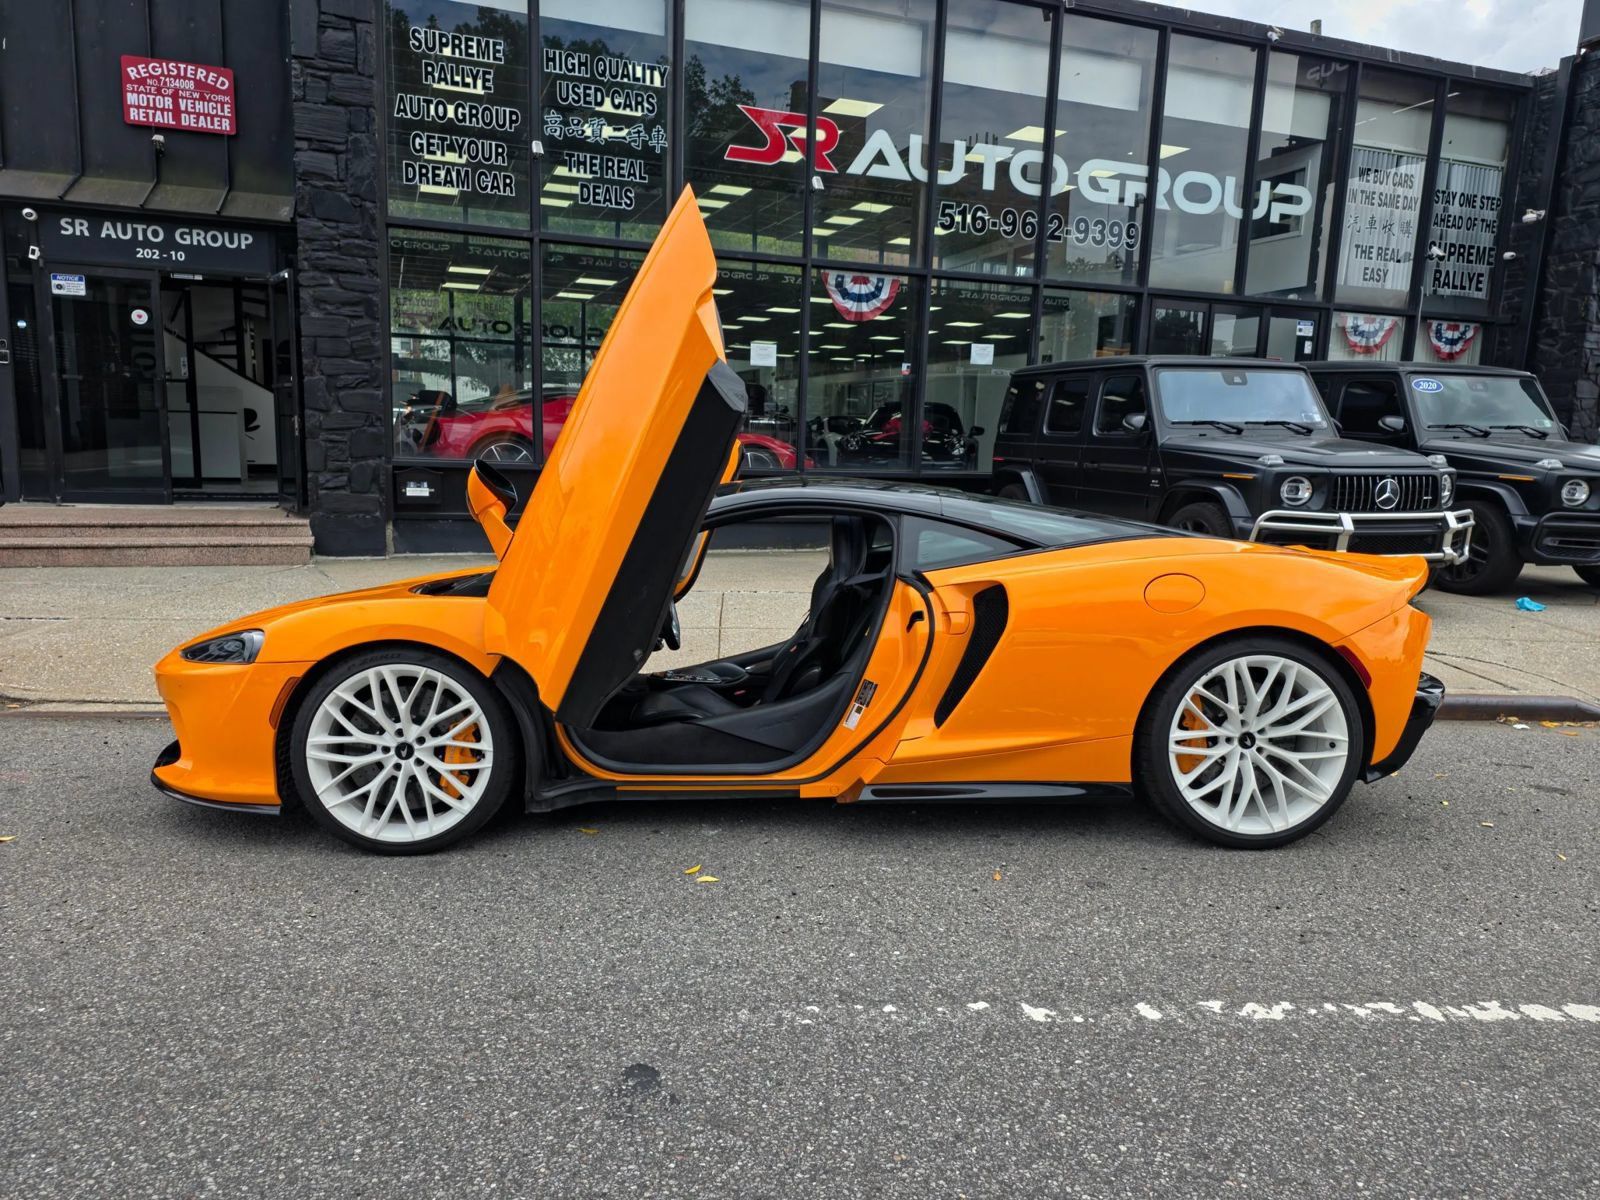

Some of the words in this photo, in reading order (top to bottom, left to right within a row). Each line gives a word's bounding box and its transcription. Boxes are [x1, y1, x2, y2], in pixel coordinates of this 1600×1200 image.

[410, 27, 504, 64] SUPREME
[127, 62, 229, 90] REGISTERED
[422, 60, 493, 93] RALLYE
[544, 49, 590, 77] HIGH
[595, 56, 669, 88] QUALITY
[126, 84, 157, 94] STATE
[179, 90, 200, 99] NEW
[204, 93, 231, 103] YORK
[127, 92, 173, 109] MOTOR
[179, 98, 232, 117] VEHICLE
[557, 82, 606, 108] USED
[609, 88, 657, 116] CARS
[129, 107, 176, 125] RETAIL
[181, 113, 230, 131] DEALER
[394, 94, 449, 123] AUTO
[453, 101, 521, 131] GROUP
[544, 109, 668, 154] 高品質二手車
[410, 131, 449, 157] GET
[451, 136, 508, 166] YOUR
[564, 151, 600, 177] THE
[603, 157, 648, 183] REAL
[724, 104, 839, 174] SR
[846, 128, 1069, 197] AUTO
[1077, 158, 1313, 223] GROUP
[403, 161, 471, 192] DREAM
[476, 169, 516, 197] CAR
[1358, 167, 1373, 184] WE
[1373, 169, 1391, 187] BUY
[1392, 172, 1415, 190] CARS
[578, 182, 635, 210] DEALS
[1348, 188, 1358, 204] IN
[1359, 189, 1377, 206] THE
[1377, 191, 1401, 210] SAME
[1401, 195, 1420, 213] DAY
[1434, 189, 1456, 207] STAY
[1458, 191, 1478, 209] ONE
[1479, 193, 1503, 211] STEP
[59, 217, 90, 237] SR
[100, 221, 165, 243] AUTO
[174, 228, 254, 250] GROUP
[1432, 213, 1463, 230] AHEAD
[1465, 216, 1478, 232] OF
[1480, 218, 1497, 235] THE
[1354, 243, 1374, 261] THE
[1376, 246, 1402, 264] REAL
[1427, 241, 1497, 267] SUPREME
[1362, 266, 1390, 283] EASY
[1431, 268, 1486, 293] RALLYE
[1419, 381, 1437, 390] 2020
